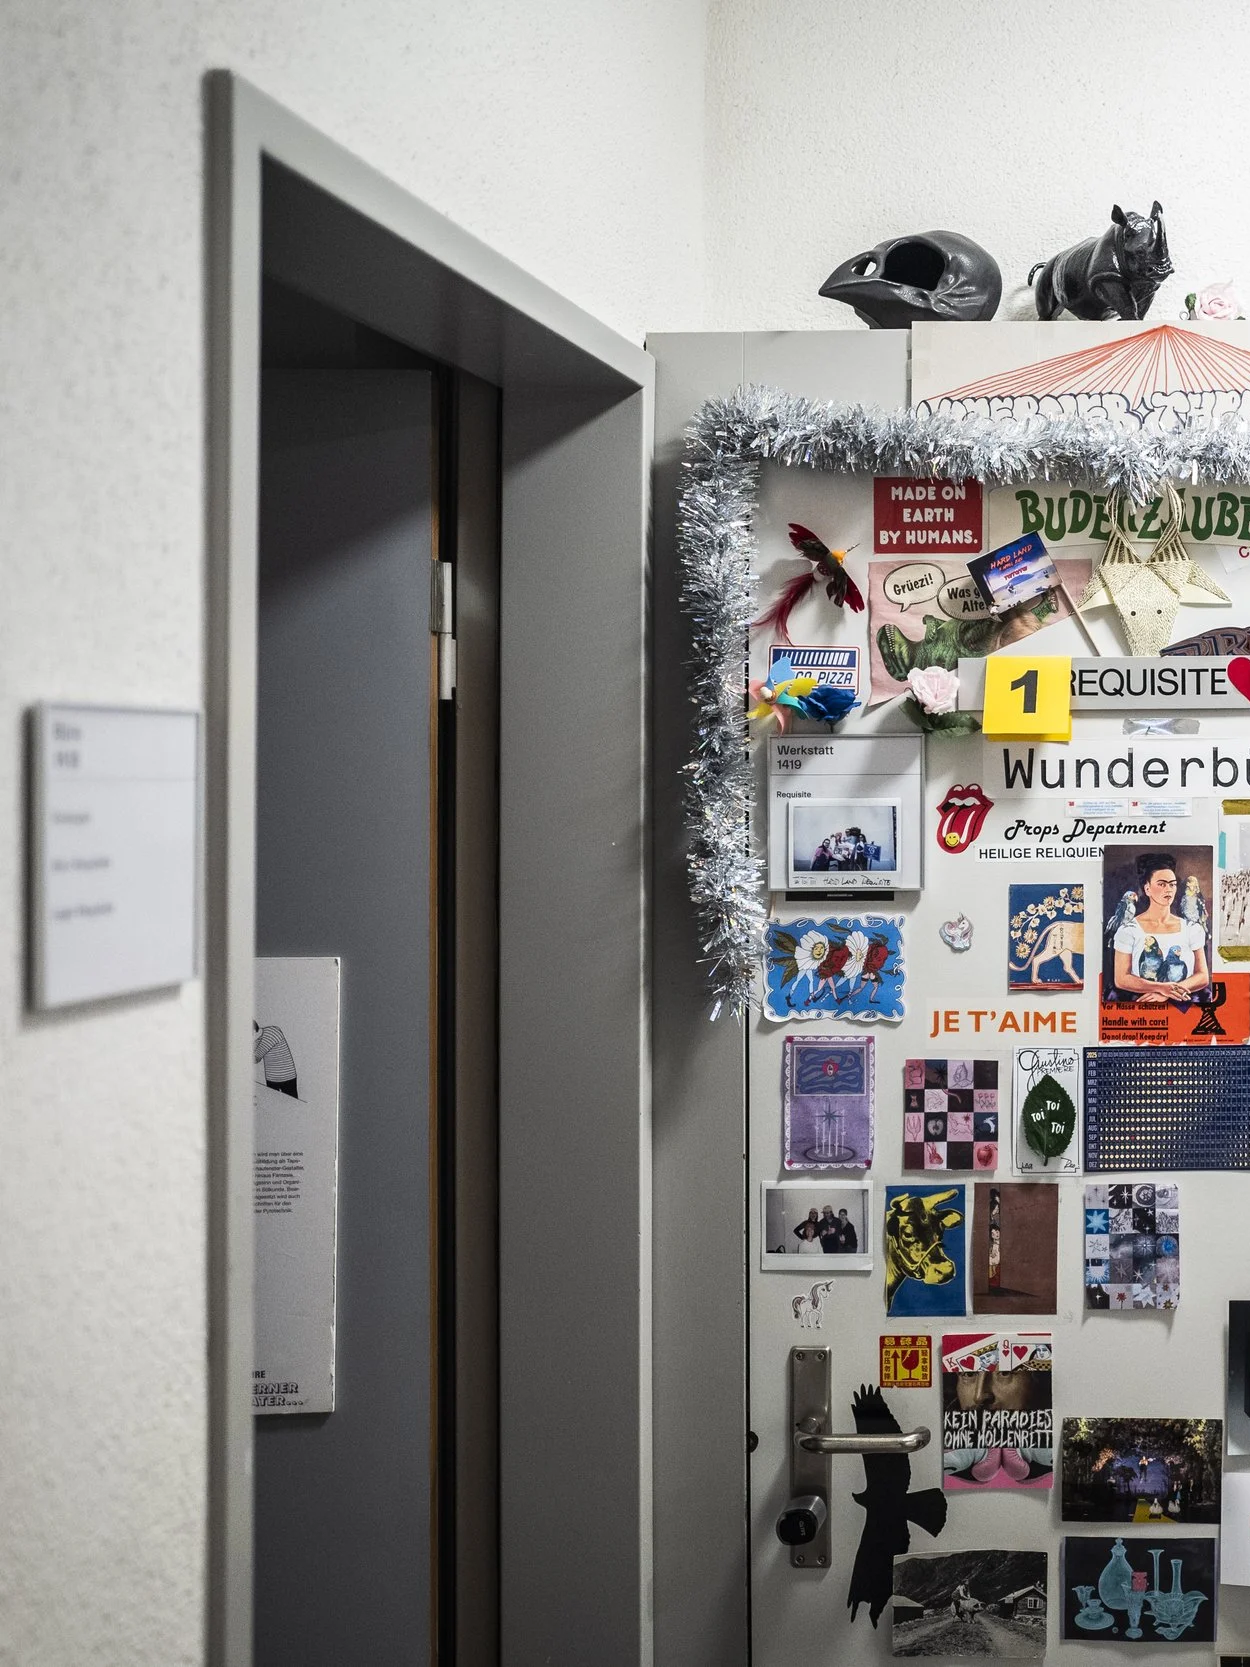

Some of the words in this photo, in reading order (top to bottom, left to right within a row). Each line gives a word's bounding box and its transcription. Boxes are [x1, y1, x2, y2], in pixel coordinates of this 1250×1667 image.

[891, 487, 937, 500] MADE
[942, 486, 966, 500] ON
[903, 508, 955, 523] EARTH
[879, 531, 901, 545] BY
[905, 529, 978, 545] HUMANS.
[1013, 544, 1033, 559] LAND
[893, 572, 934, 596] Grüezi!
[947, 587, 971, 600] Was
[817, 671, 854, 685] PIZZA
[1010, 669, 1039, 714] 1
[777, 745, 834, 756] Werkstatt
[777, 759, 802, 770] 1419
[776, 790, 812, 800] Requisite
[1004, 818, 1060, 843] Props
[1063, 818, 1167, 843] Depatment
[978, 847, 1032, 860] HEILIGE
[930, 1010, 960, 1038] JE
[1102, 1016, 1129, 1026] Handle
[1131, 1016, 1148, 1026] with
[1149, 1016, 1169, 1026] care!
[944, 1411, 978, 1429] KEIN
[981, 1409, 1052, 1431] PARADIES
[944, 1430, 974, 1448] OHNE
[977, 1428, 1052, 1450] HÖLLENRITT
